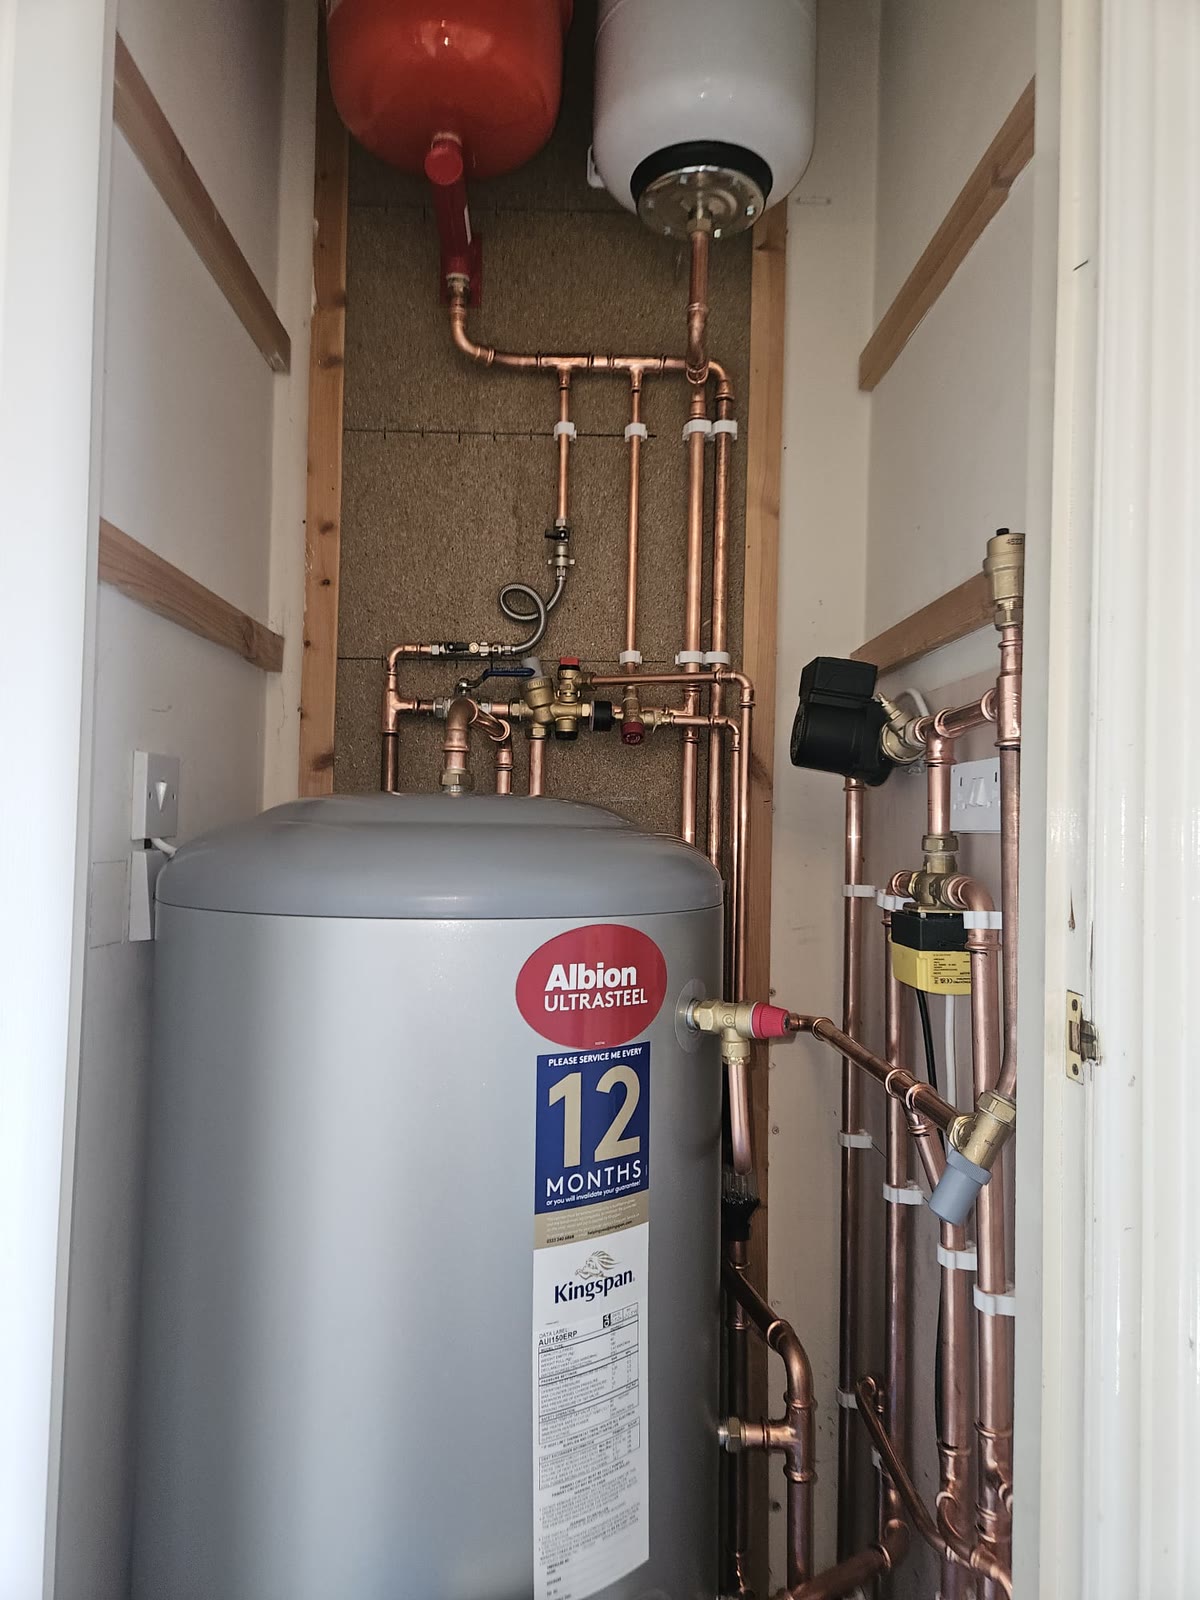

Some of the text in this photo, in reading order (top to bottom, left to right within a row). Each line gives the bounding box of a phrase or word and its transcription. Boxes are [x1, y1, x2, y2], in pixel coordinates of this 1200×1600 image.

[544, 962, 637, 992] Albion
[544, 988, 648, 1012] ULTRASTEEL
[548, 1047, 642, 1067] PLEASE SERVICE ME EVERY
[548, 1065, 640, 1168] 12
[546, 1160, 642, 1197] MONTHS
[553, 1197, 565, 1206] you
[565, 1195, 576, 1203] will
[576, 1191, 603, 1201] invalidate
[603, 1188, 615, 1197] your
[614, 1180, 641, 1194] guarantee!
[554, 1269, 634, 1304] Kingspan
